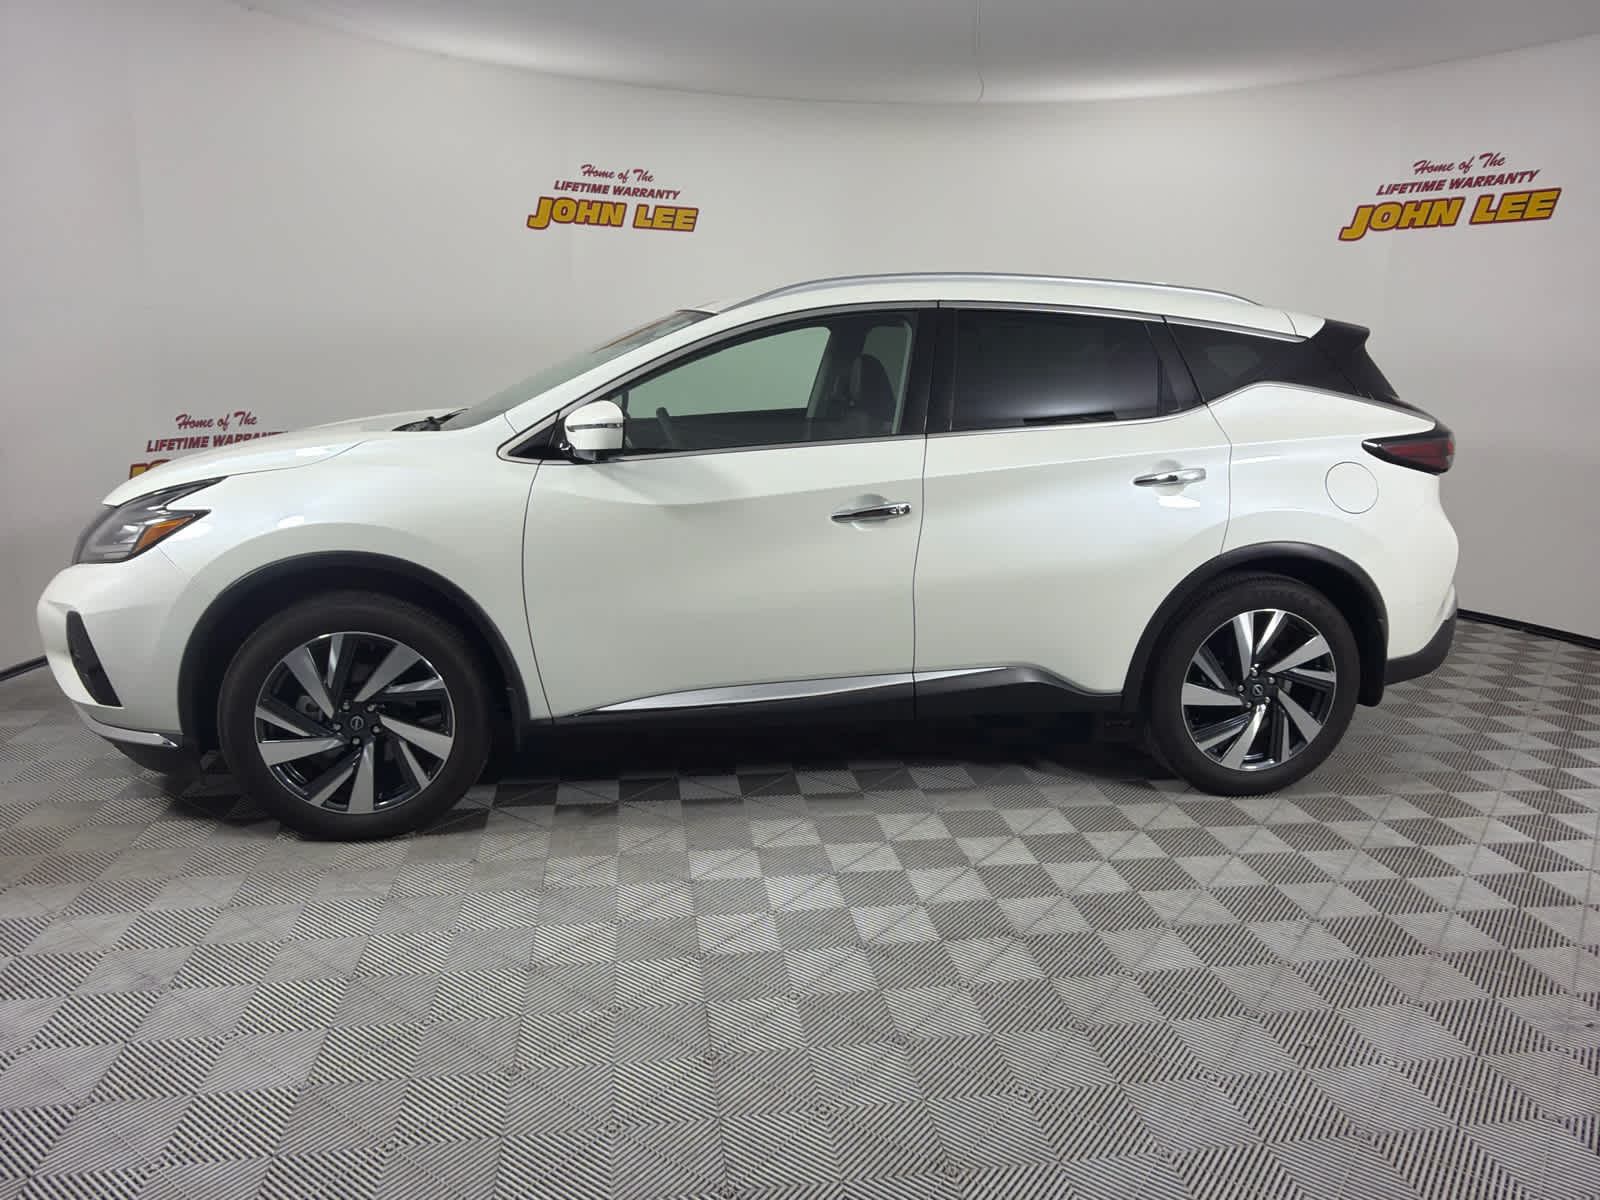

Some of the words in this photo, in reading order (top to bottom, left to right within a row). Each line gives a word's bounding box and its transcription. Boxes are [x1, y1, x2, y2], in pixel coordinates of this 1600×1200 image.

[581, 164, 615, 177] Home
[617, 169, 629, 183] of
[633, 169, 654, 182] The
[1413, 160, 1454, 174] Home
[1458, 156, 1474, 173] of
[1479, 152, 1505, 168] The
[554, 180, 610, 195] LIFETIME
[612, 185, 680, 200] WARRANTY
[1376, 179, 1446, 196] LIFETIME
[1449, 169, 1540, 190] WARRANTY
[527, 197, 627, 230] JOHN
[633, 204, 699, 232] LEE
[1338, 197, 1466, 241] JOHN
[1469, 188, 1562, 225] LEE
[175, 414, 214, 430] Home
[217, 413, 230, 431] of
[234, 411, 258, 426] The
[146, 436, 210, 453] LIFETIME
[213, 431, 288, 447] WARR
